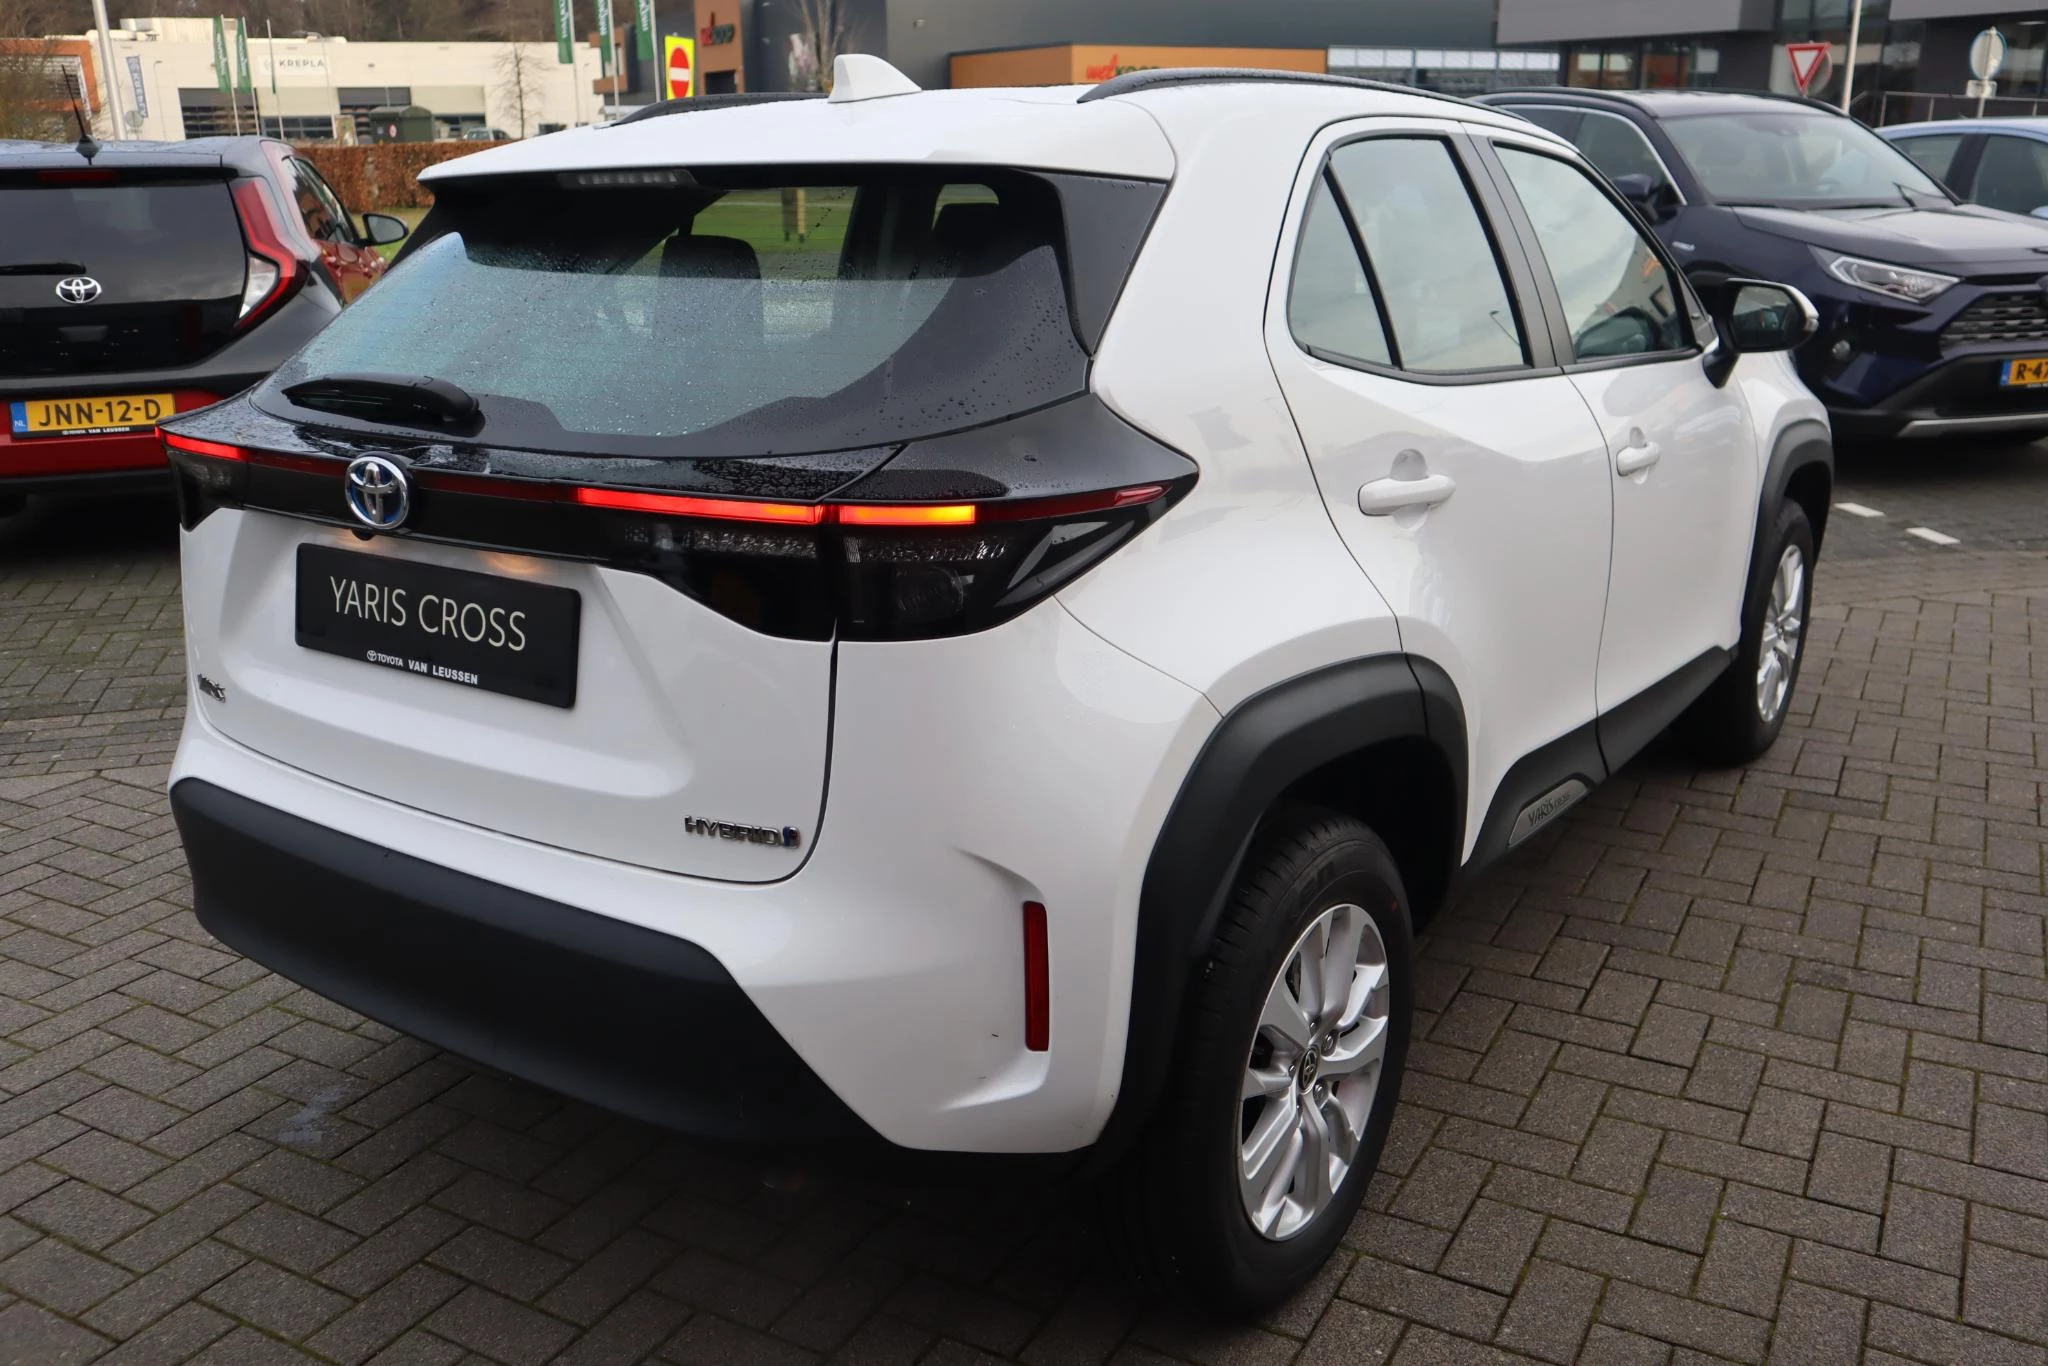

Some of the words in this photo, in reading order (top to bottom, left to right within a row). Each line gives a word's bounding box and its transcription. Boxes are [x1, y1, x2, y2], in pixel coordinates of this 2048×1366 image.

[279, 58, 326, 68] KREPLA
[39, 399, 161, 426] JNN-12-D
[330, 575, 406, 627] YARIS
[418, 594, 526, 651] CROSS
[377, 652, 404, 667] TOYOTA
[408, 659, 428, 674] VAN
[432, 664, 479, 685] LEUSSEN
[684, 815, 781, 847] HYBRID
